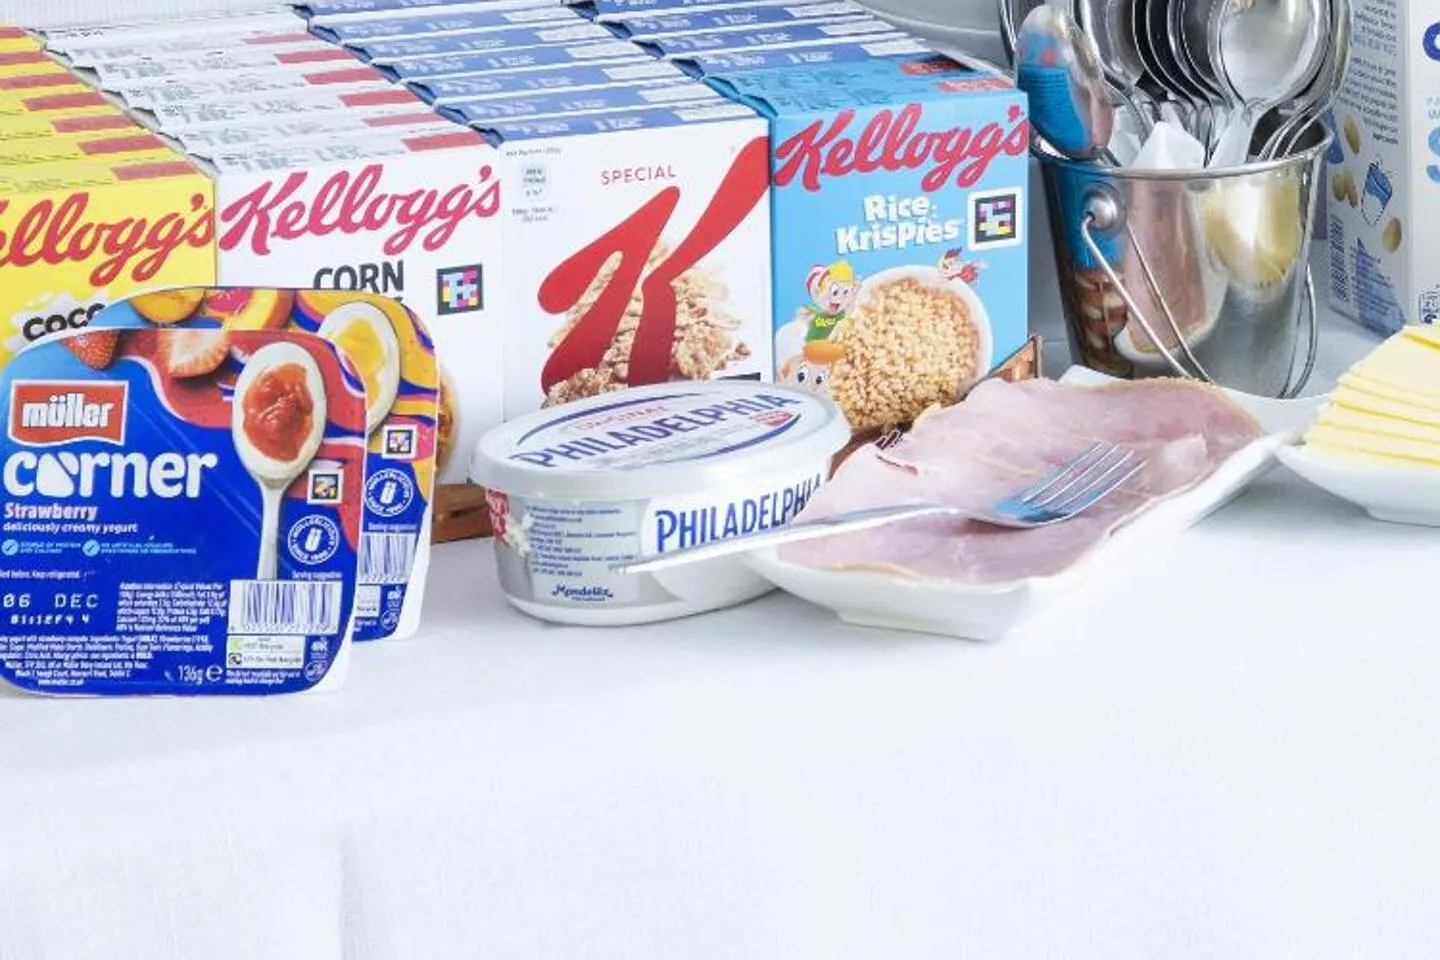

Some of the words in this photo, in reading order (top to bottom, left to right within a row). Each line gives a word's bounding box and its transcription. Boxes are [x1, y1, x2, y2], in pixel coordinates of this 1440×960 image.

[774, 103, 1029, 192] Kellogg's
[601, 165, 677, 185] SPECIAL
[218, 164, 501, 256] Kellogg's
[864, 195, 932, 222] Rice
[0, 192, 214, 287] llogg's
[835, 217, 965, 254] Krispies
[313, 260, 404, 293] CORN
[537, 136, 771, 395] K
[22, 393, 114, 427] müller
[508, 393, 802, 468] PHILADELPHIA
[3, 451, 218, 498] corner
[3, 503, 98, 522] Strawberry
[3, 522, 59, 533] deliciously
[62, 523, 100, 534] creamy
[102, 523, 138, 534] yogurt
[54, 593, 98, 608] DEC
